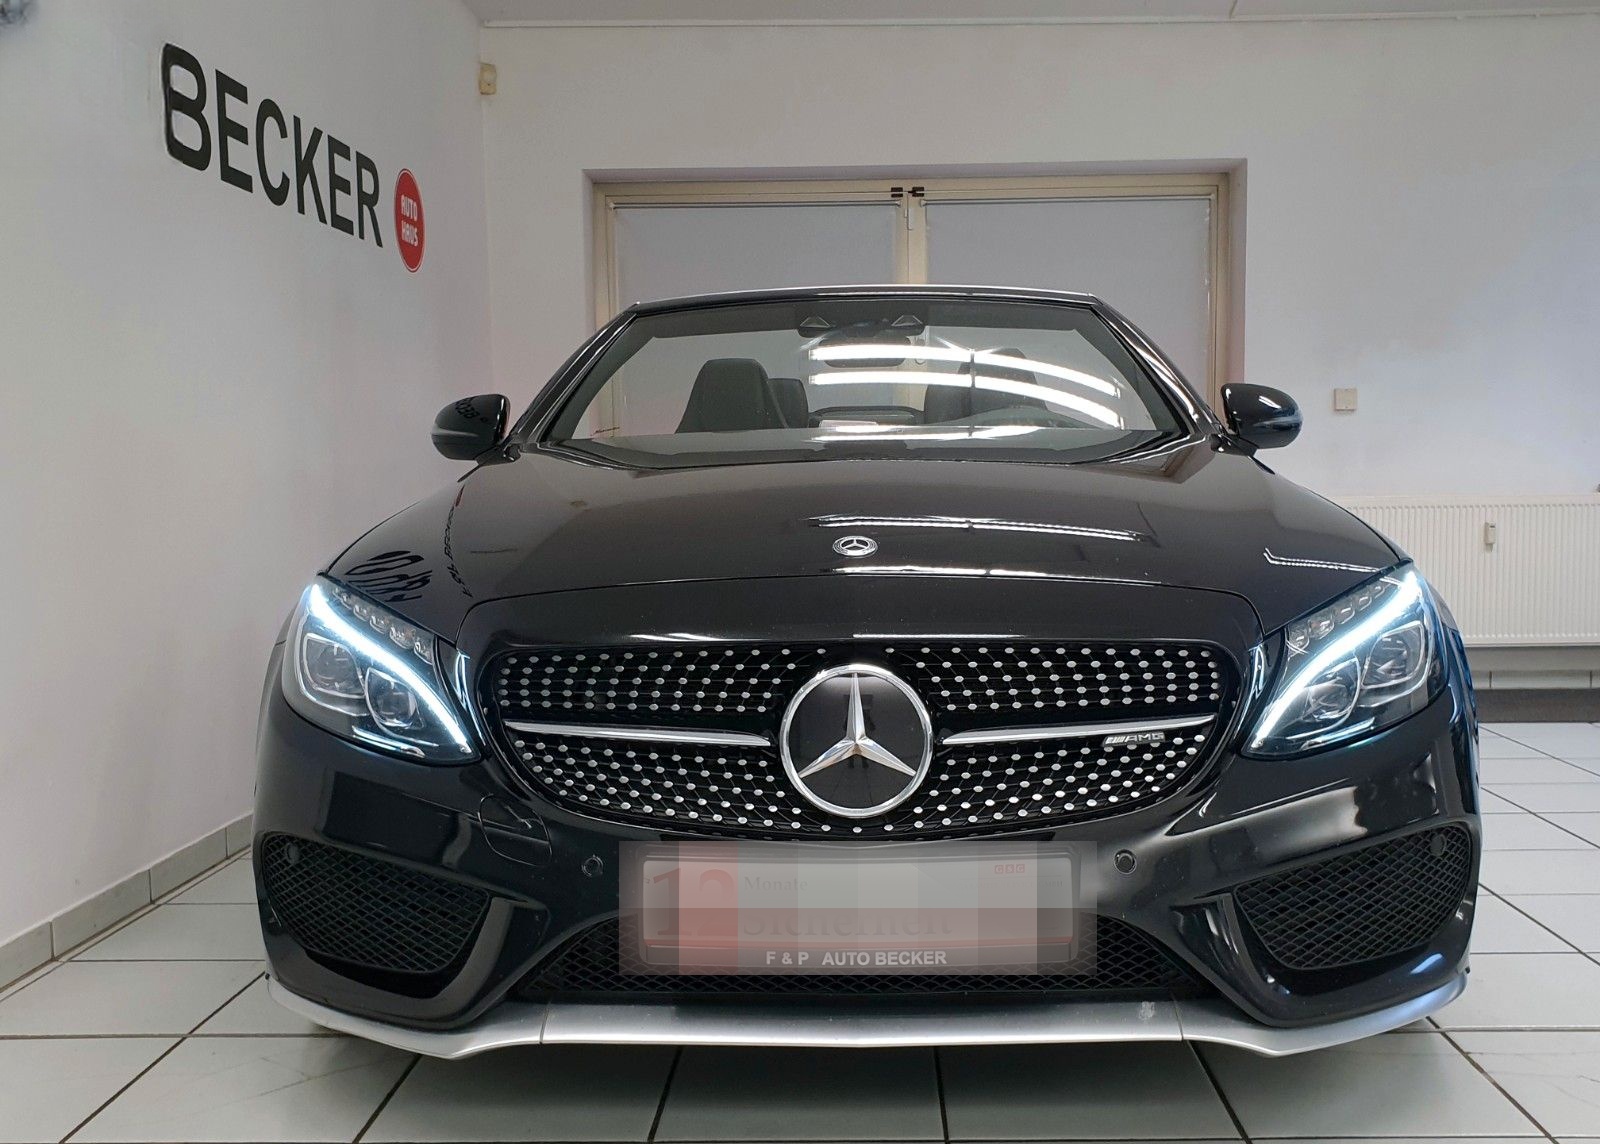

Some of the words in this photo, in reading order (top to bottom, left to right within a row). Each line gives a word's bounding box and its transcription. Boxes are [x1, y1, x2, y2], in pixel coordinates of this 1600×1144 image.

[161, 43, 383, 248] BECKER
[401, 194, 418, 222] AUTO
[401, 220, 419, 247] HAUS
[1124, 732, 1165, 743] AMG
[993, 863, 1026, 875] GSG
[743, 875, 809, 892] Monate
[653, 867, 737, 936] 12
[766, 951, 777, 965] F
[781, 951, 793, 965] &
[798, 951, 810, 965] P
[821, 951, 871, 966] AUTO
[874, 950, 947, 966] BECKER
